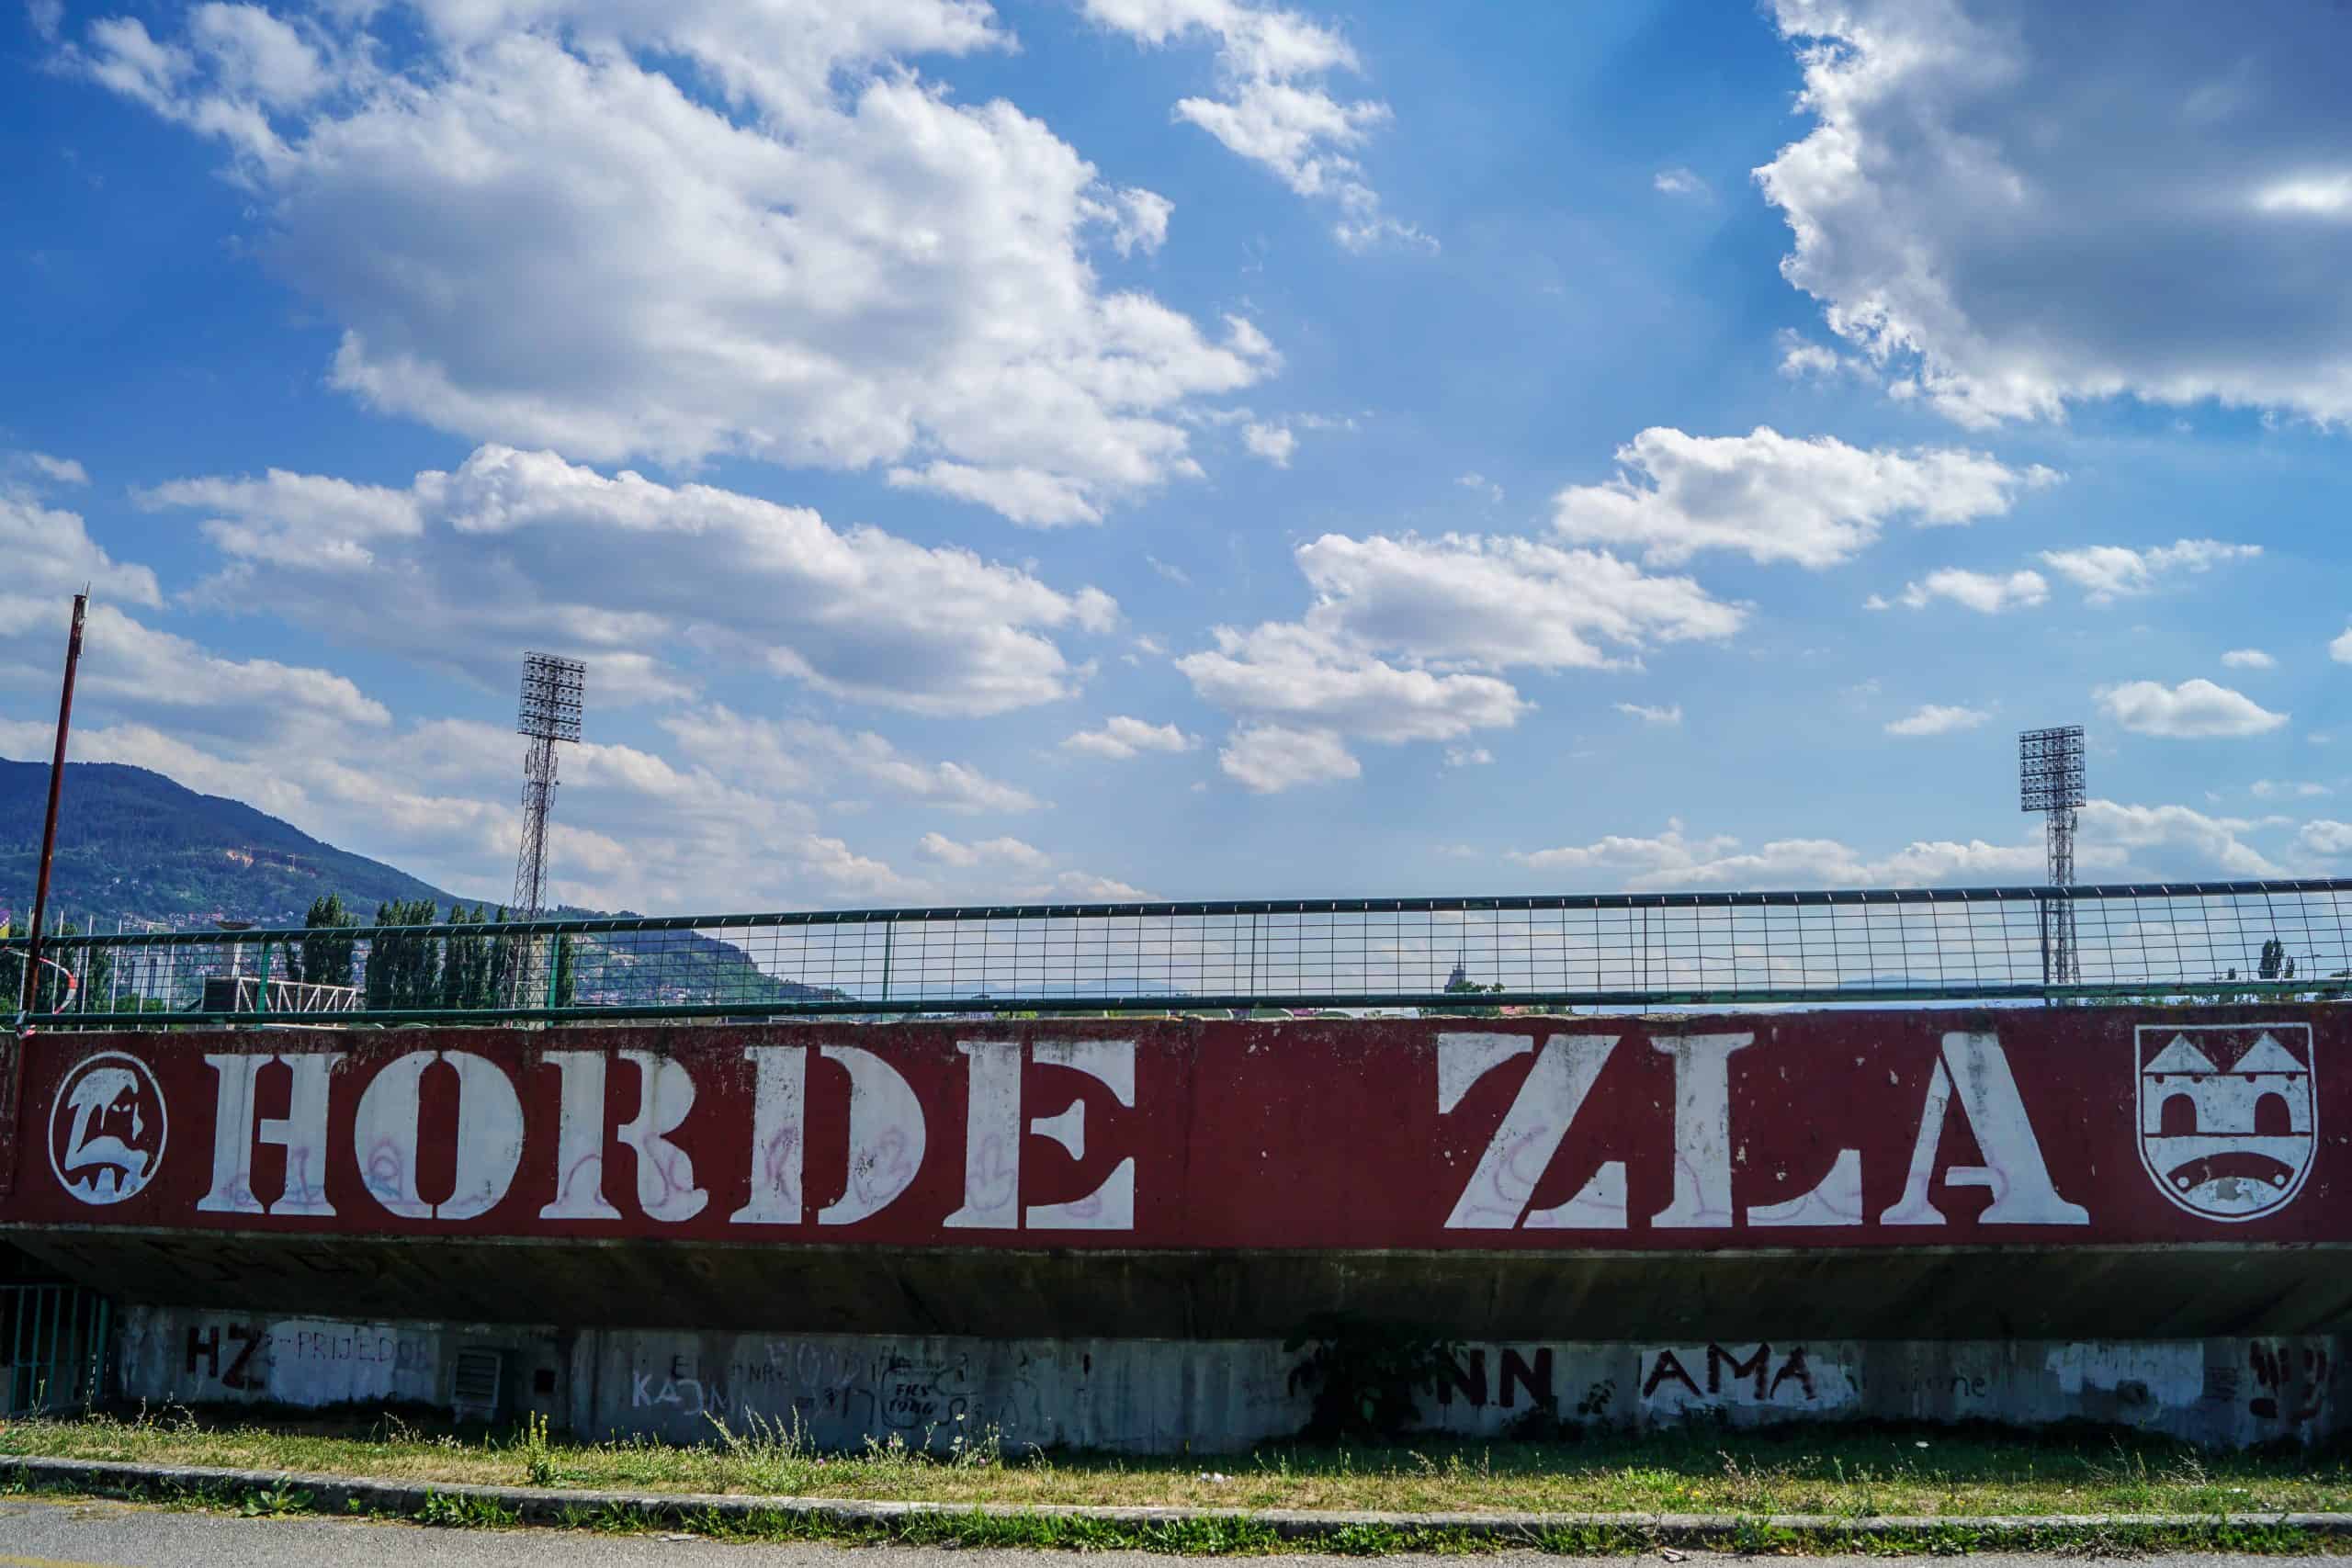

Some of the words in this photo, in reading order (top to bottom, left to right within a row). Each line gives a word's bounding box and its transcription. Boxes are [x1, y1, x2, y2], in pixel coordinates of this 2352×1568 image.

[197, 1041, 1135, 1230] HORDE
[1438, 1032, 2090, 1229] ZLA
[187, 1323, 266, 1390] HZ
[1643, 1339, 1815, 1401] AMA
